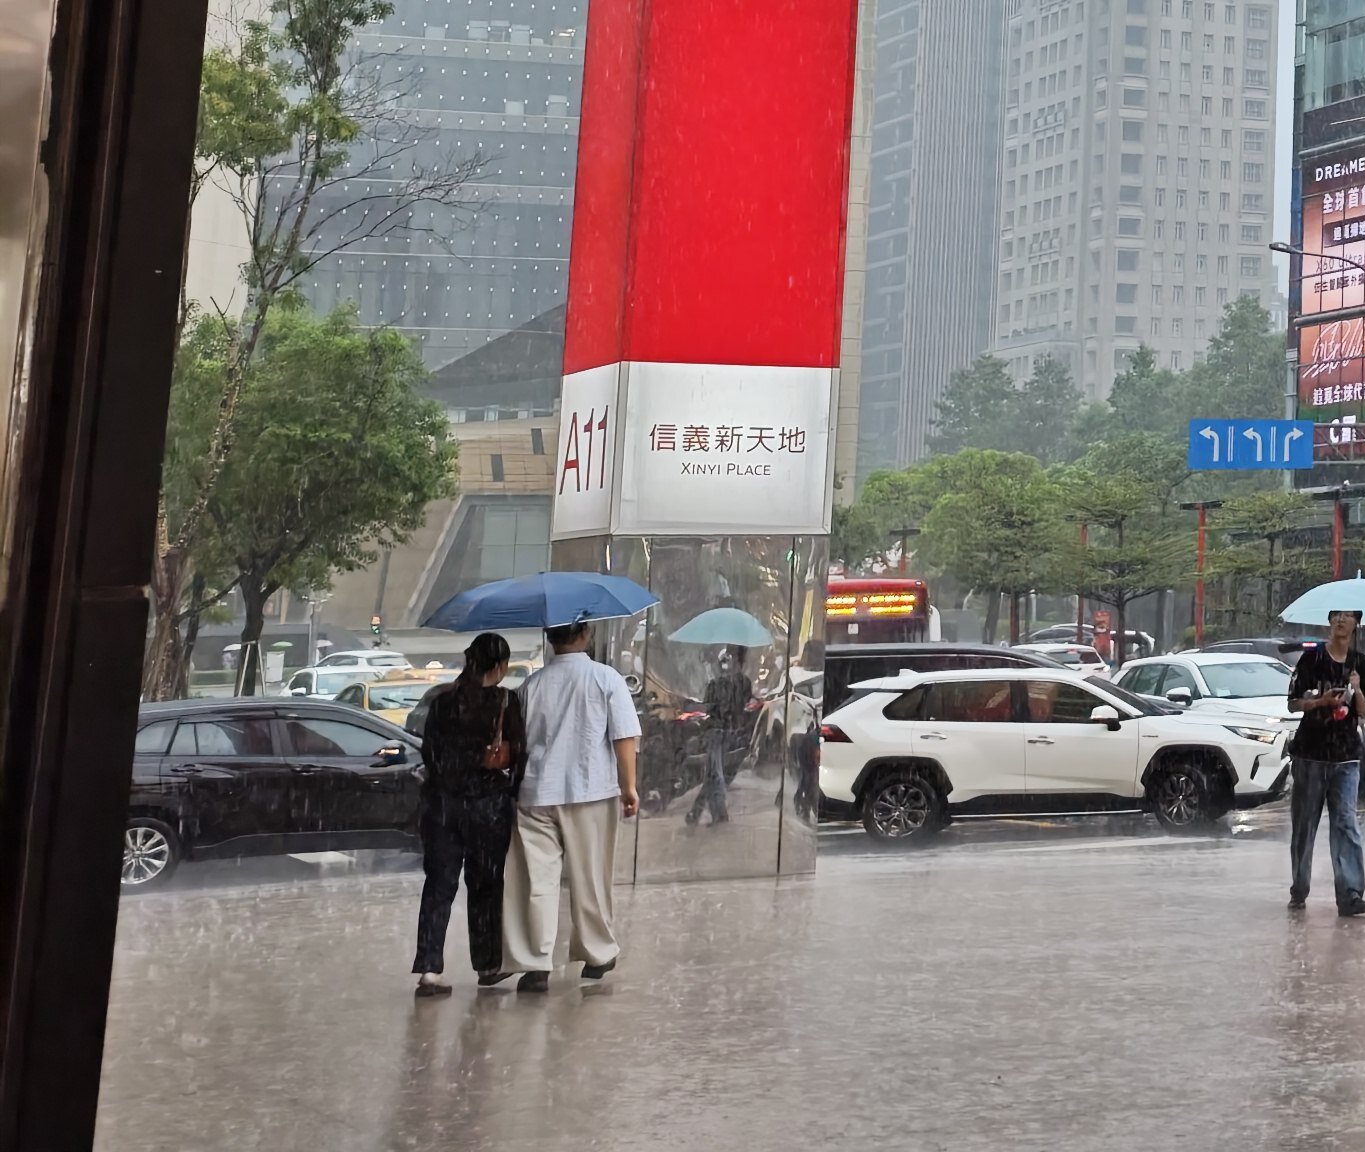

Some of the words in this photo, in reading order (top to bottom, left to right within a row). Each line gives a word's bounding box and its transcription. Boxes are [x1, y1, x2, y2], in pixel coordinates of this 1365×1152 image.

[558, 403, 610, 496] A11
[649, 422, 807, 455] 信義新天地
[681, 461, 722, 477] XINYI
[726, 462, 772, 478] PLACE
